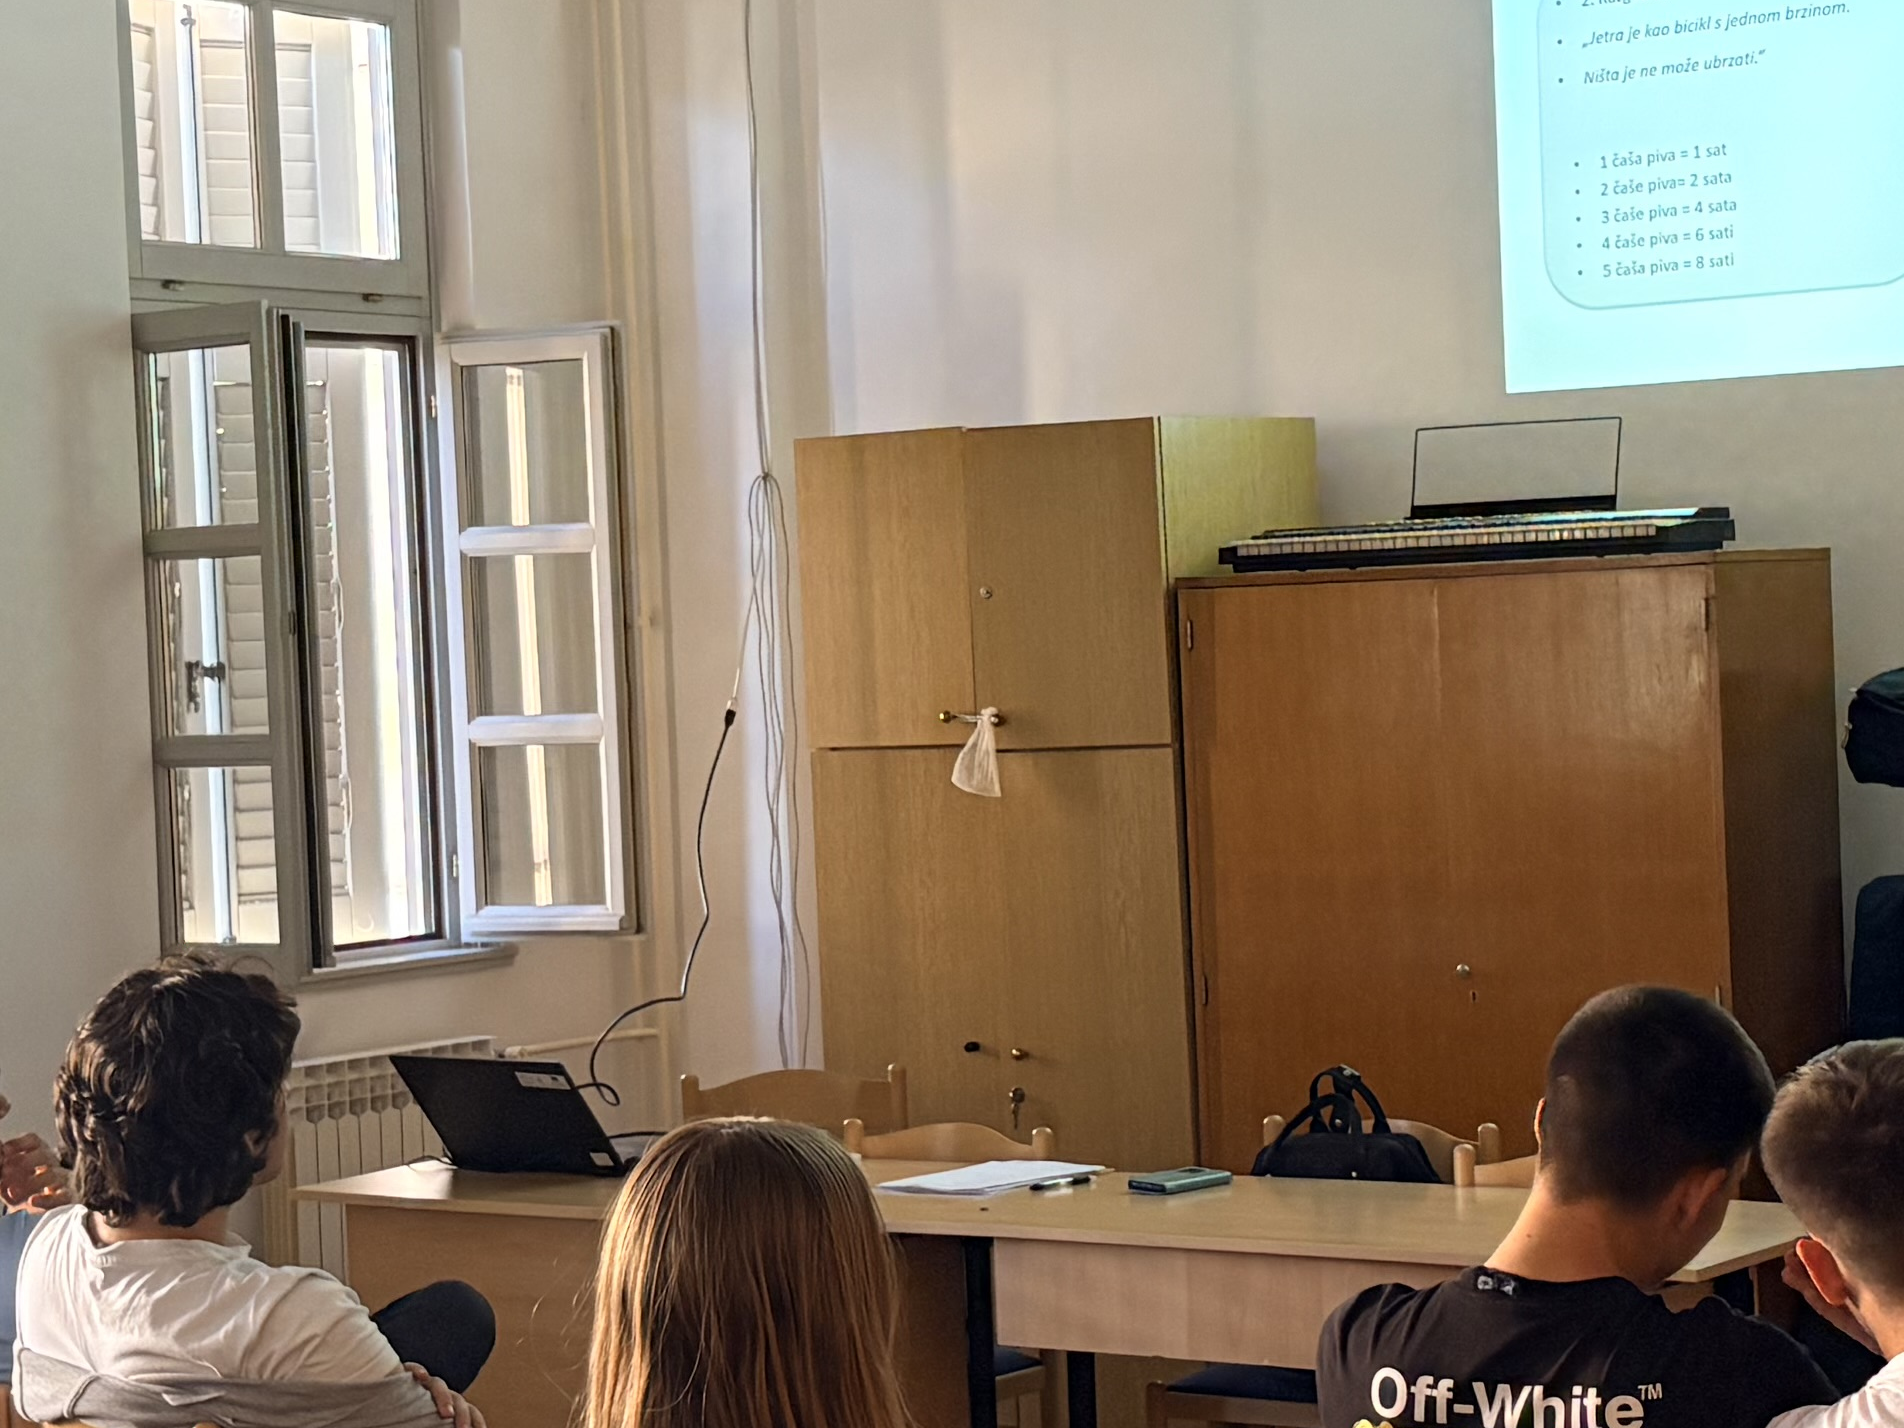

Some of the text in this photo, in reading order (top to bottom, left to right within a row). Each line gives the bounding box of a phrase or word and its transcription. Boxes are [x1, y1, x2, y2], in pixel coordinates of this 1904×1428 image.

[1626, 26, 1640, 44] je
[1645, 24, 1670, 38] kao
[1674, 16, 1711, 34] bicikl
[1714, 18, 1722, 29] s
[1725, 11, 1780, 31] jednom
[1785, 3, 1850, 20] brzinom.
[1584, 68, 1619, 84] Ništa
[1622, 66, 1636, 83] je
[1640, 66, 1657, 77] ne
[1661, 58, 1699, 75] može
[1600, 156, 1607, 169] 1
[1612, 151, 1642, 167] čaša
[1647, 149, 1676, 166] piva
[1693, 145, 1701, 159] 1
[1706, 144, 1727, 157] sat
[1601, 183, 1608, 196] 2
[1613, 179, 1643, 195] čaše
[1690, 174, 1698, 187] 2
[1703, 172, 1732, 186] sata
[1602, 210, 1609, 223] 3
[1649, 205, 1677, 222] piva
[1694, 201, 1703, 213] 4
[1708, 200, 1737, 213] sata
[1602, 237, 1610, 249] 4
[1650, 232, 1678, 248] piva
[1696, 228, 1704, 241] 6
[1709, 224, 1734, 240] sati
[1603, 264, 1611, 278] 5
[1615, 261, 1645, 276] čaša
[1650, 259, 1679, 276] piva
[1696, 256, 1704, 269] 8
[1709, 252, 1734, 268] sati
